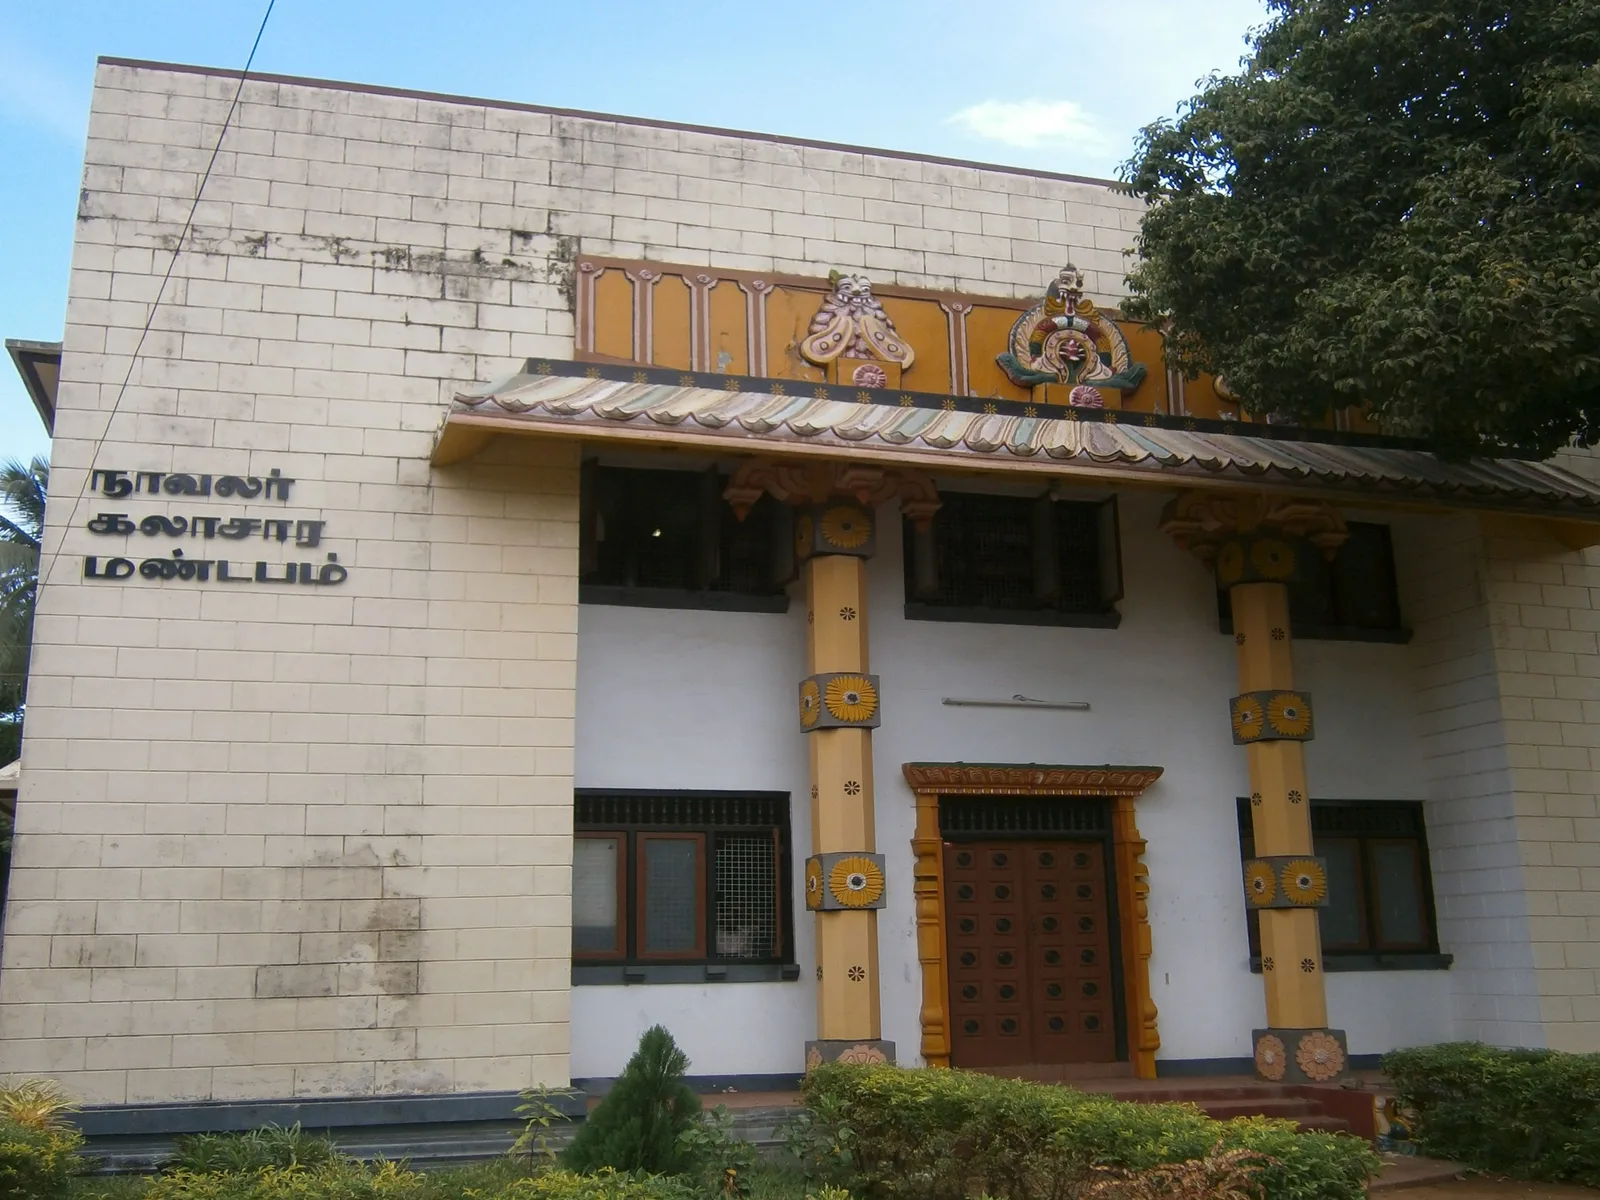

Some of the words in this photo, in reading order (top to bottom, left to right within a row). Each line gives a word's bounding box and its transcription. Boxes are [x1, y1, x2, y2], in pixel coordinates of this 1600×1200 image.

[91, 468, 295, 500] நாவலர்
[87, 513, 326, 547] கலாசார
[84, 548, 347, 585] மண்டபம்
